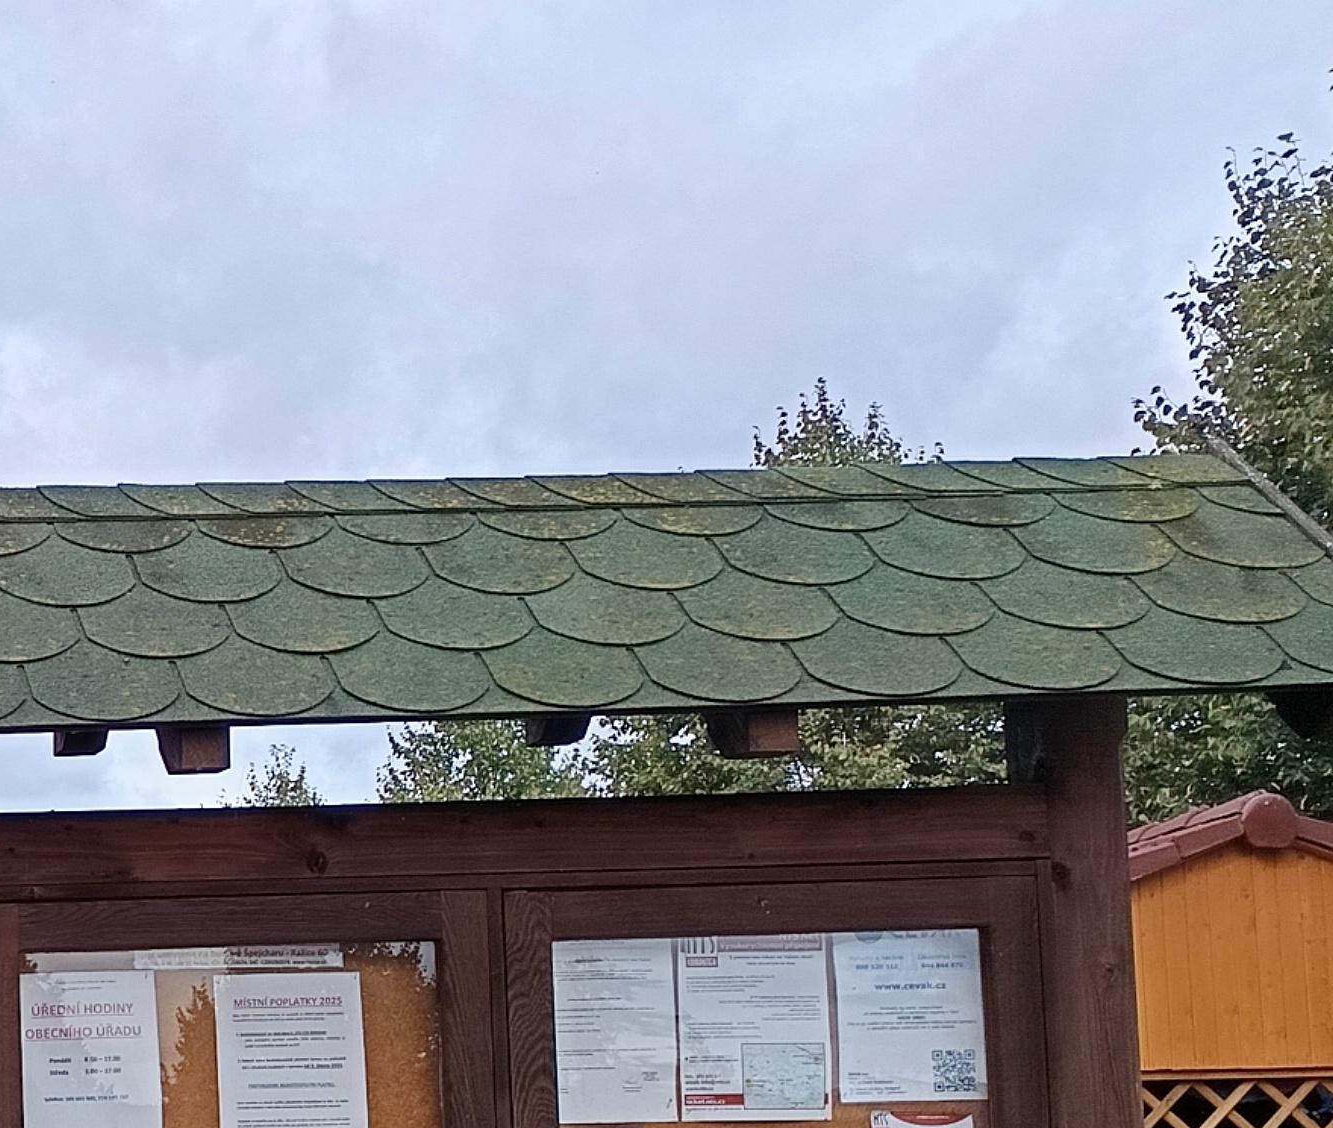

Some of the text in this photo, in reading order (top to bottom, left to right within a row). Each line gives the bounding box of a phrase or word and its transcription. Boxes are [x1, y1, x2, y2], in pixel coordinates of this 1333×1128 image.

[31, 1001, 134, 1017] ÚŘEDNÍ HODINY
[234, 995, 343, 1007] MÍSTNÍ POPLATKY 2025
[25, 1023, 142, 1040] OBECNÍHO ÚŘADU
